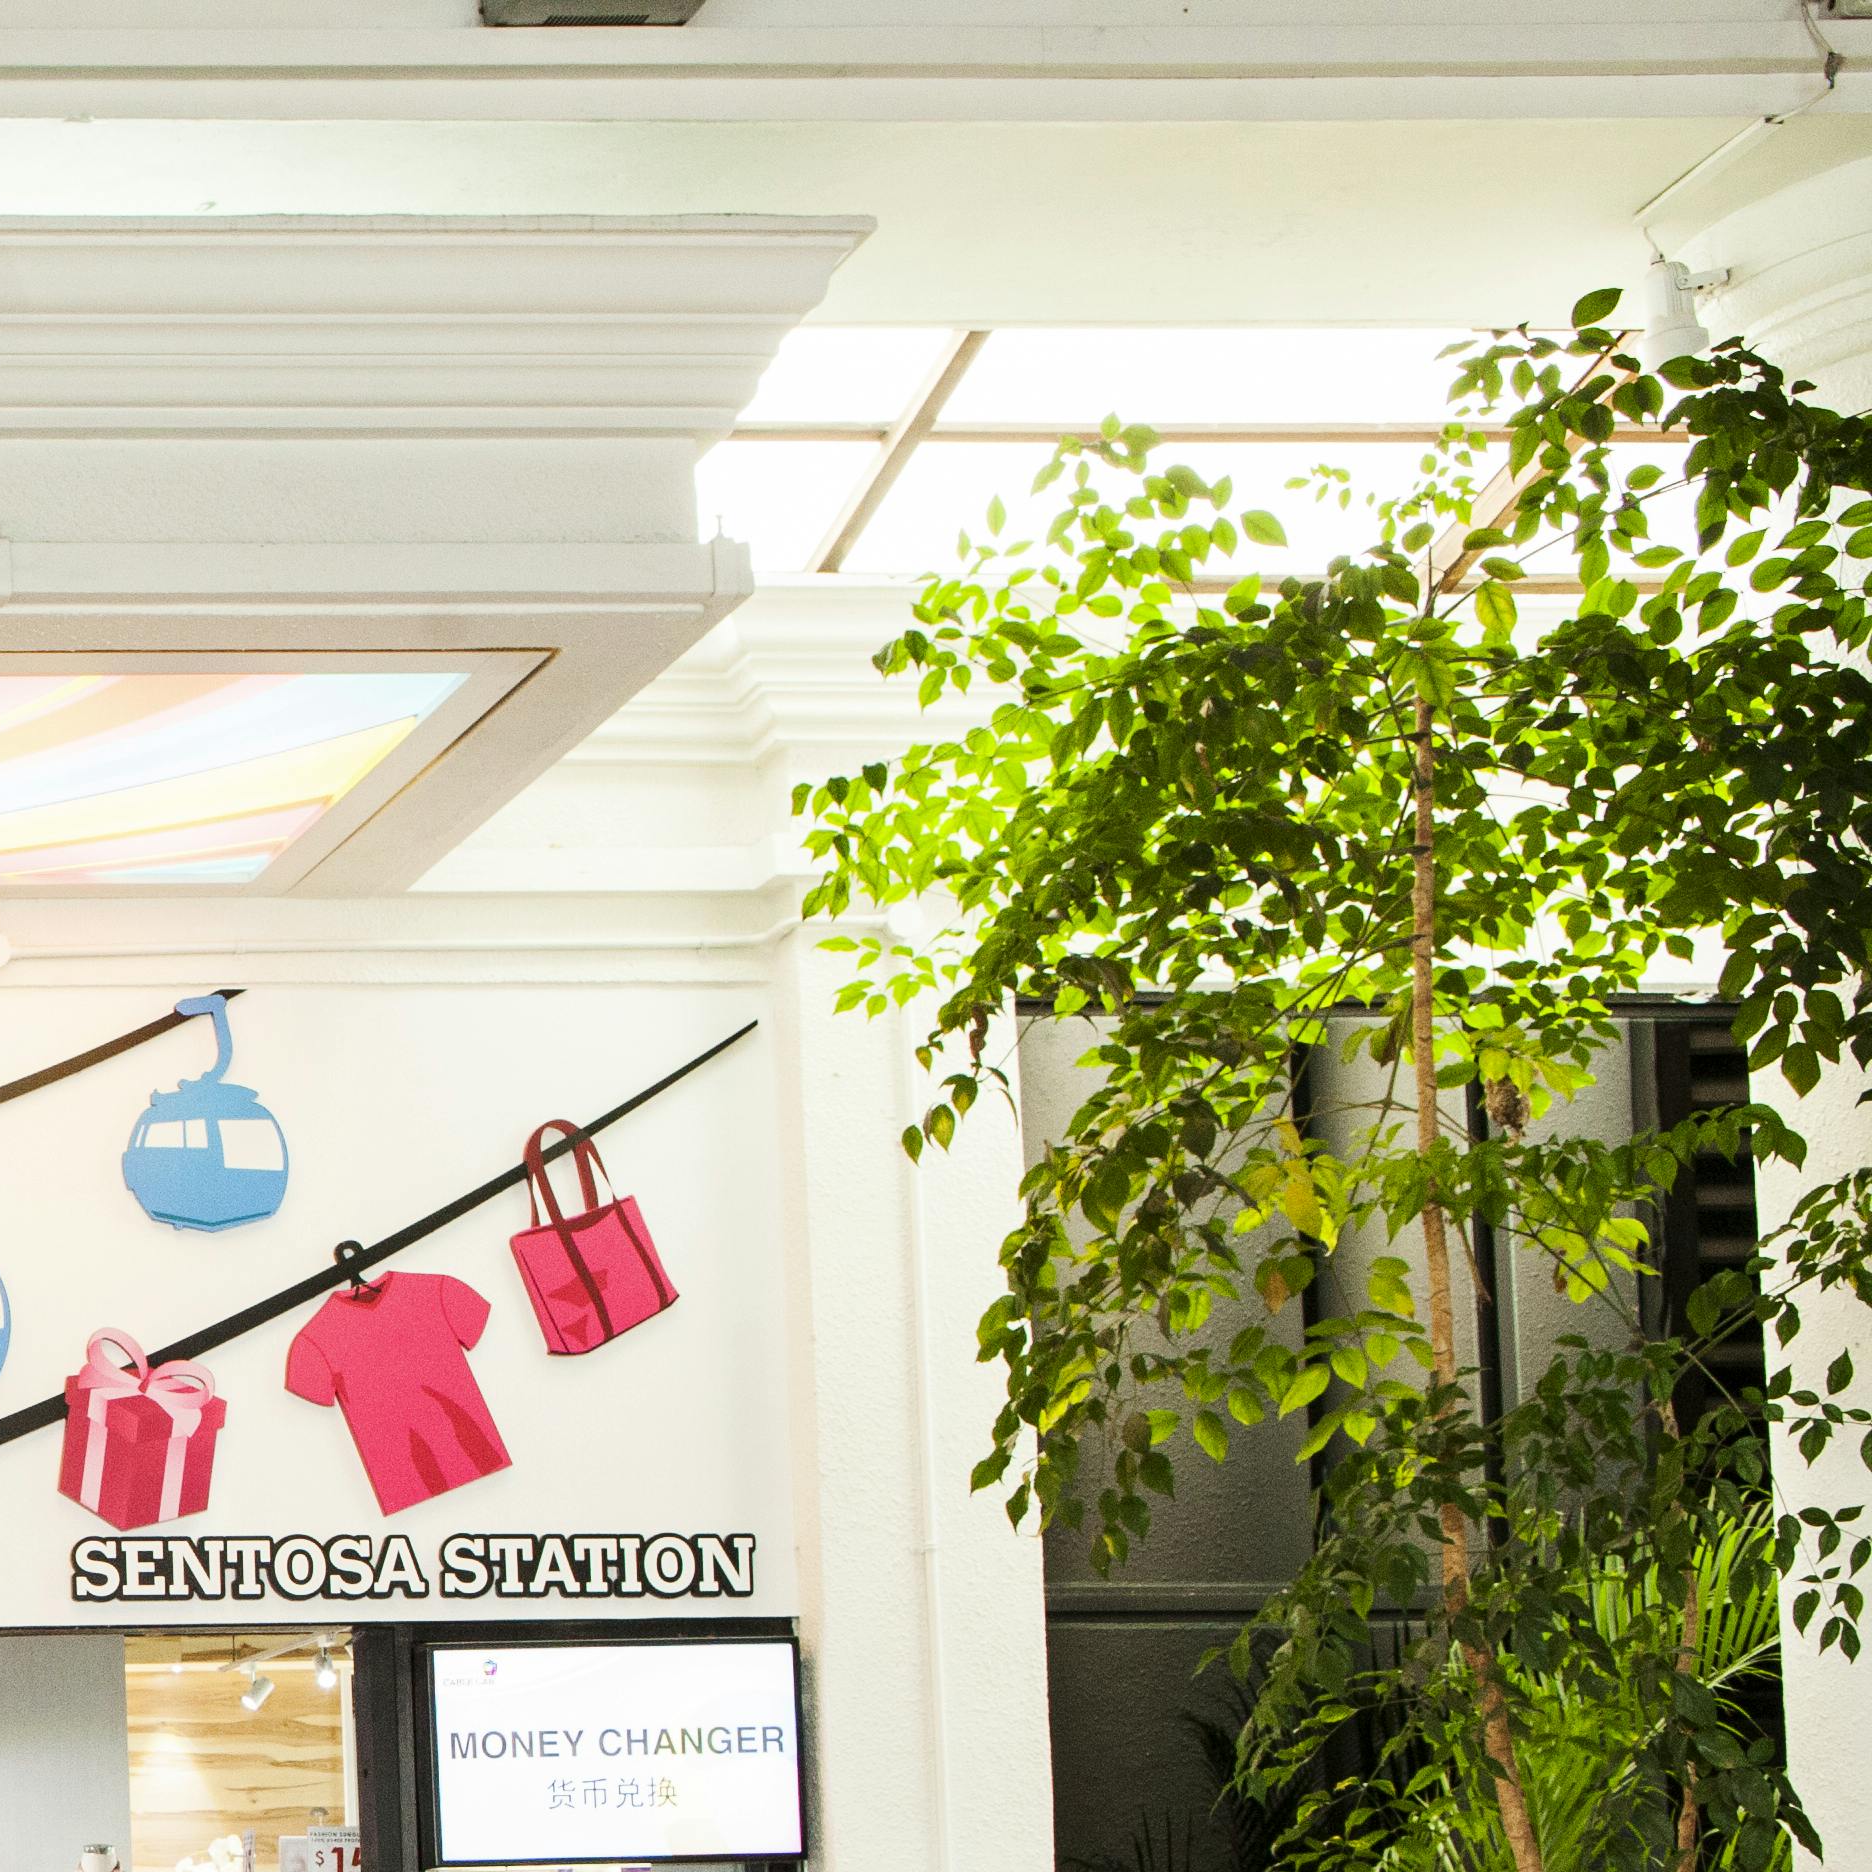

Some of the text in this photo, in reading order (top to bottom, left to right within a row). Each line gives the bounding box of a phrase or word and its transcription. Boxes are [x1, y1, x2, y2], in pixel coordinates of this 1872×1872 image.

[71, 1533, 756, 1600] SENTOSA STATION
[450, 1725, 785, 1760] MONEY CHANGER
[547, 1777, 679, 1809] 货币兑换
